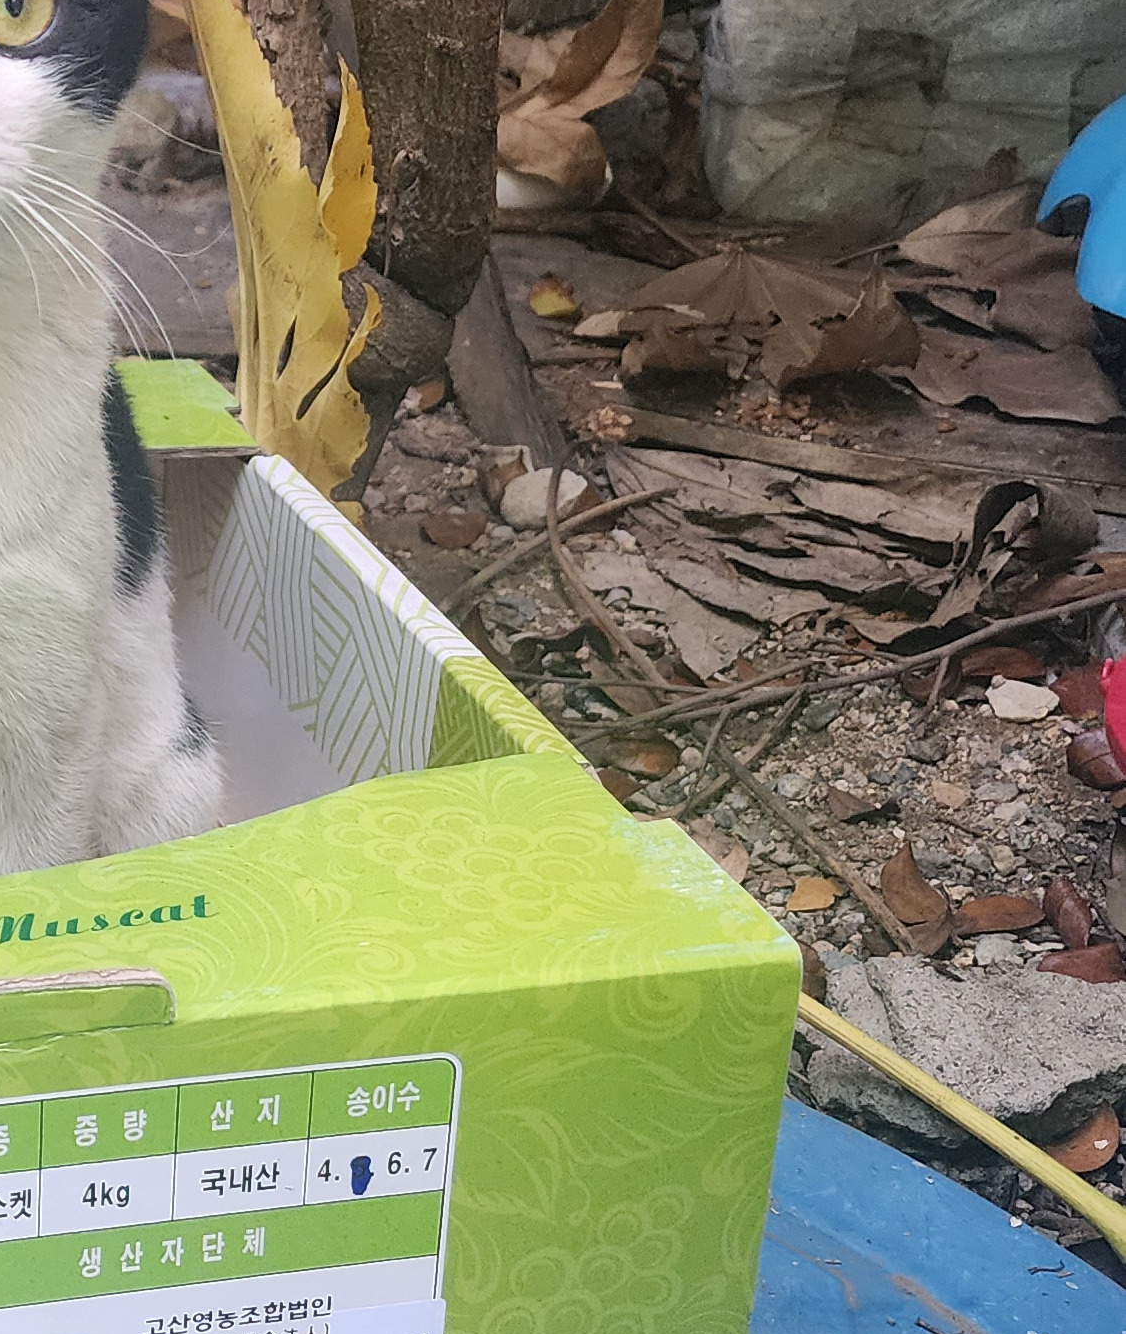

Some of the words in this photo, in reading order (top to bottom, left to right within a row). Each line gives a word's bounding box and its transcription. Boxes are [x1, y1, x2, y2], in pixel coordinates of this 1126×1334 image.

[346, 1081, 421, 1117] 송이수
[82, 1182, 131, 1208] 4kg
[201, 1161, 280, 1196] 국내산
